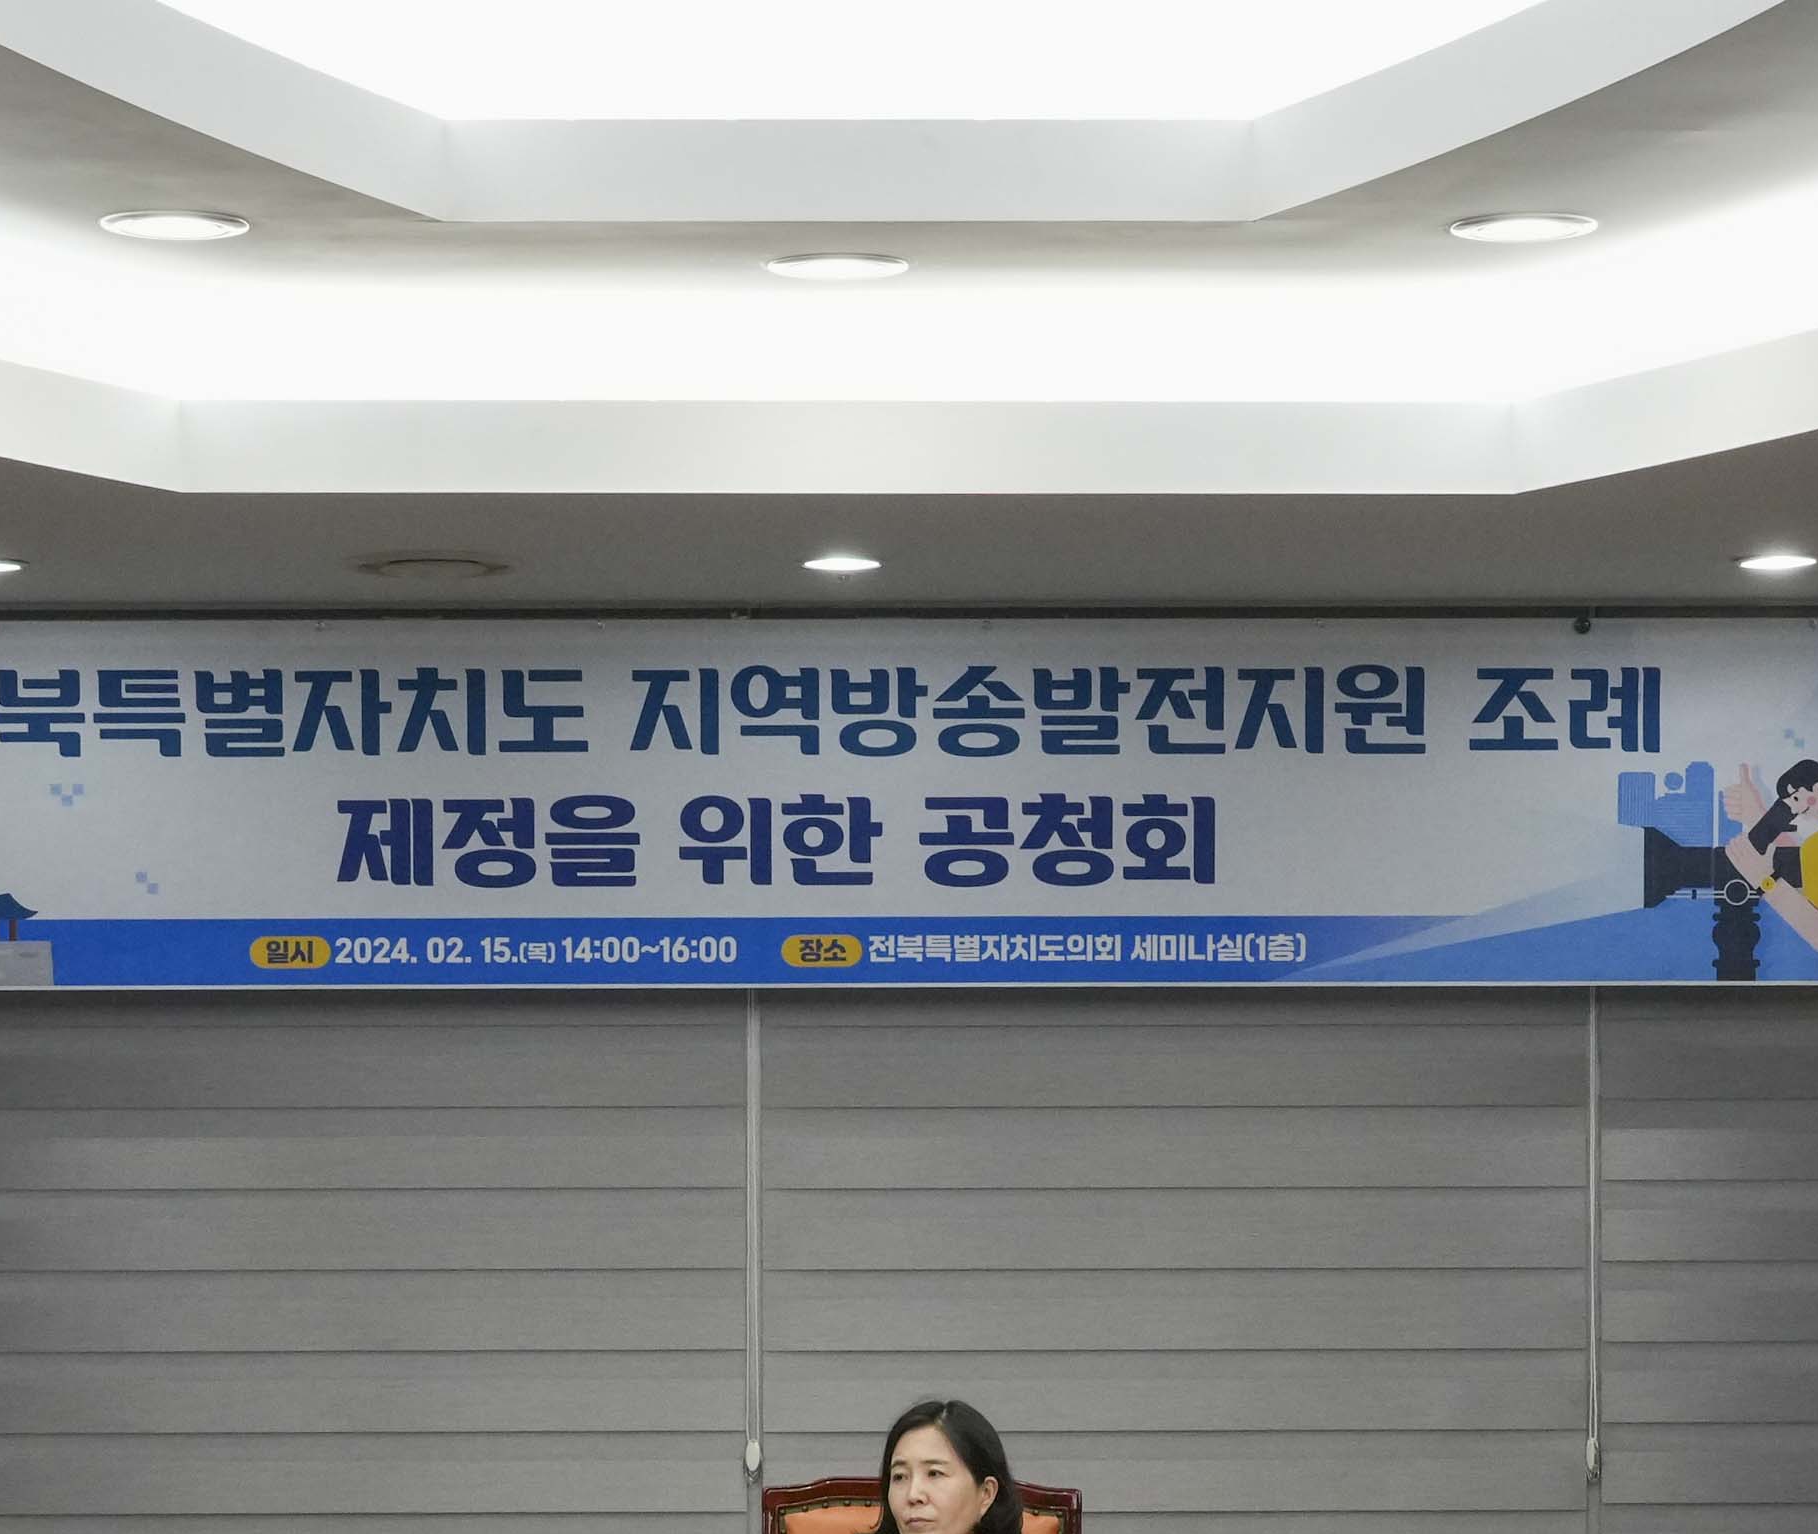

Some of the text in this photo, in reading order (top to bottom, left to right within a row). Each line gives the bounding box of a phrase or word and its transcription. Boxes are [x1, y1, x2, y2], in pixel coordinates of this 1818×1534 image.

[629, 664, 1428, 759] 지역방송발전지원
[1469, 667, 1662, 755] 조례
[337, 793, 1218, 890] 제정을 위한 공청회
[265, 939, 314, 964] 일시
[335, 937, 419, 965] 2024.
[426, 937, 473, 965] 02.
[561, 936, 739, 965] 14:00~16:00
[798, 938, 849, 964] 장소
[868, 933, 1308, 964] 전북특별자치도의회 세미나실(1층)
